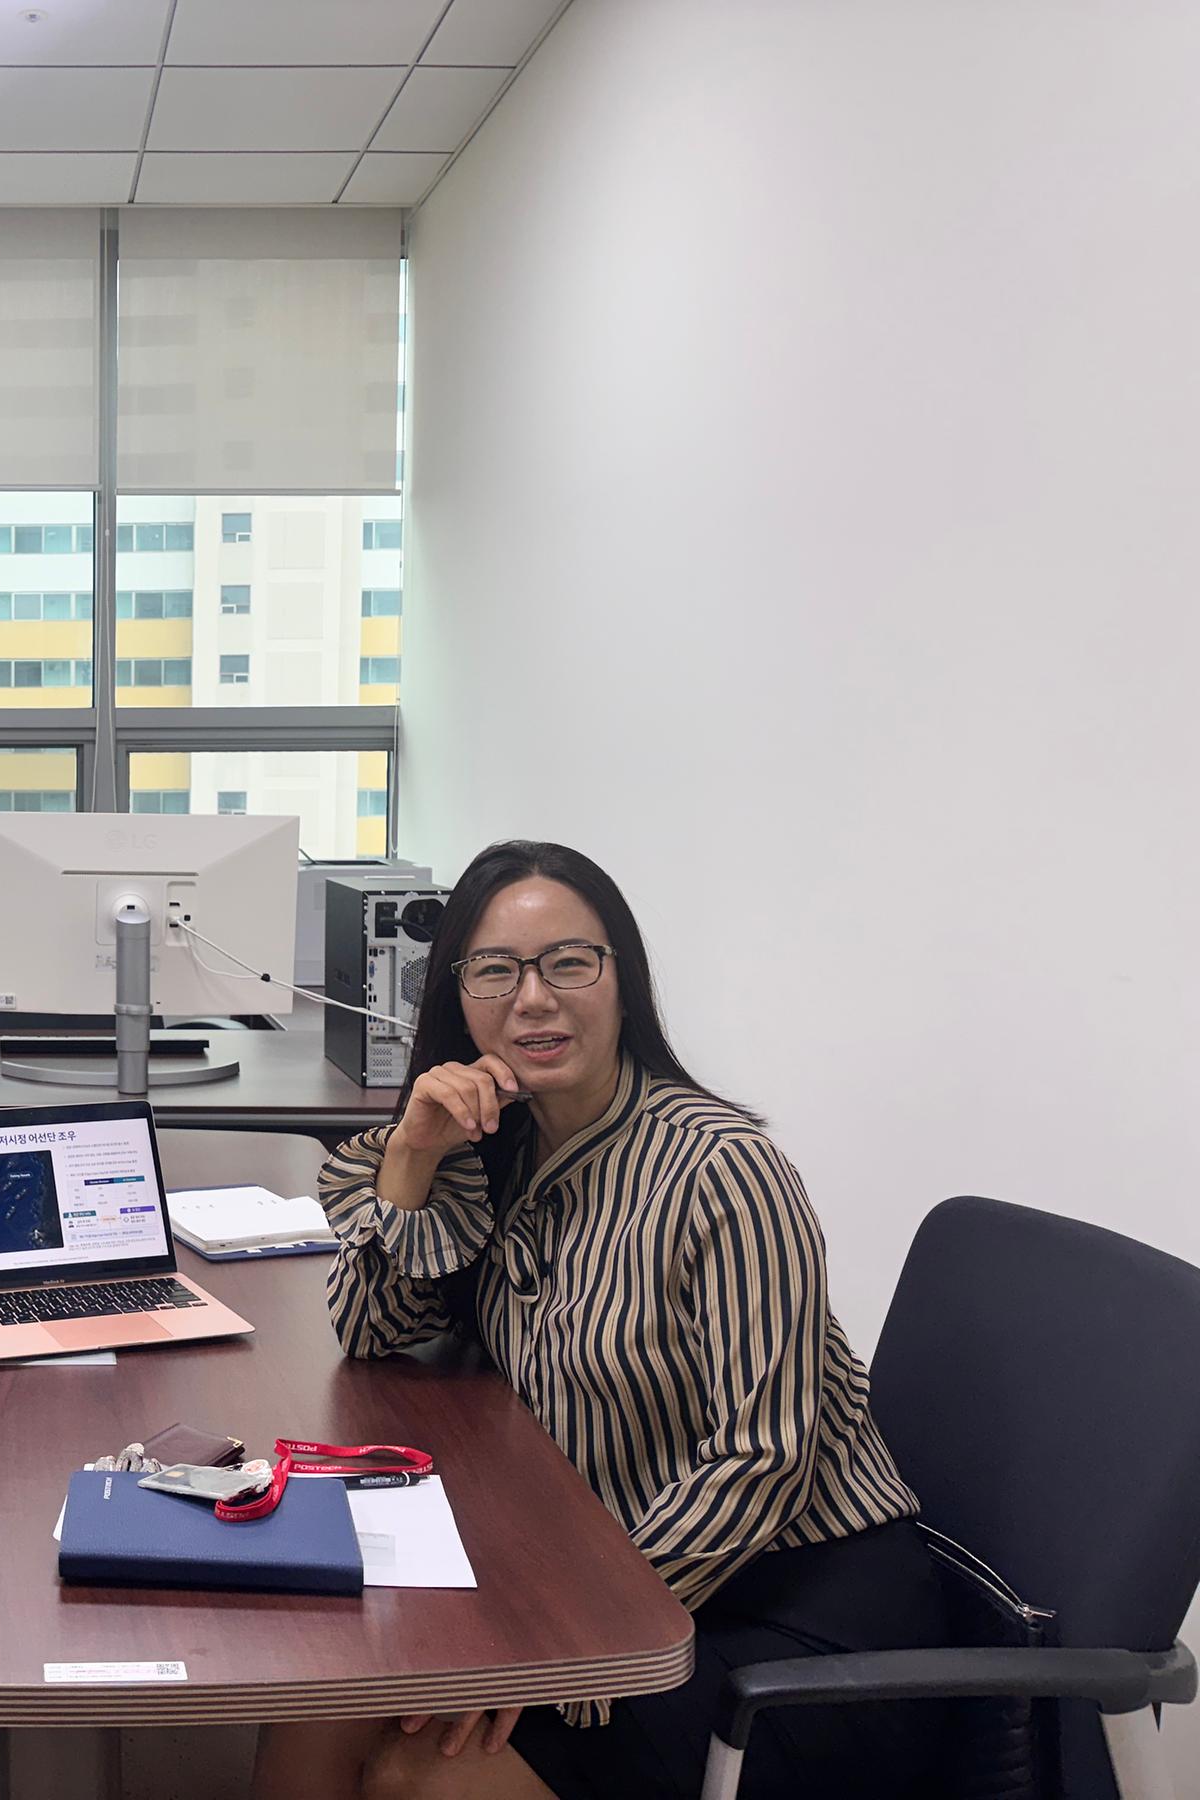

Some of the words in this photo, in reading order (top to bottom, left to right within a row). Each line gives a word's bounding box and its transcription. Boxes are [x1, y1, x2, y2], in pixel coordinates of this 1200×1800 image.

[131, 833, 158, 849] LG
[28, 1132, 56, 1144] 어선단
[58, 1130, 77, 1142] 조우
